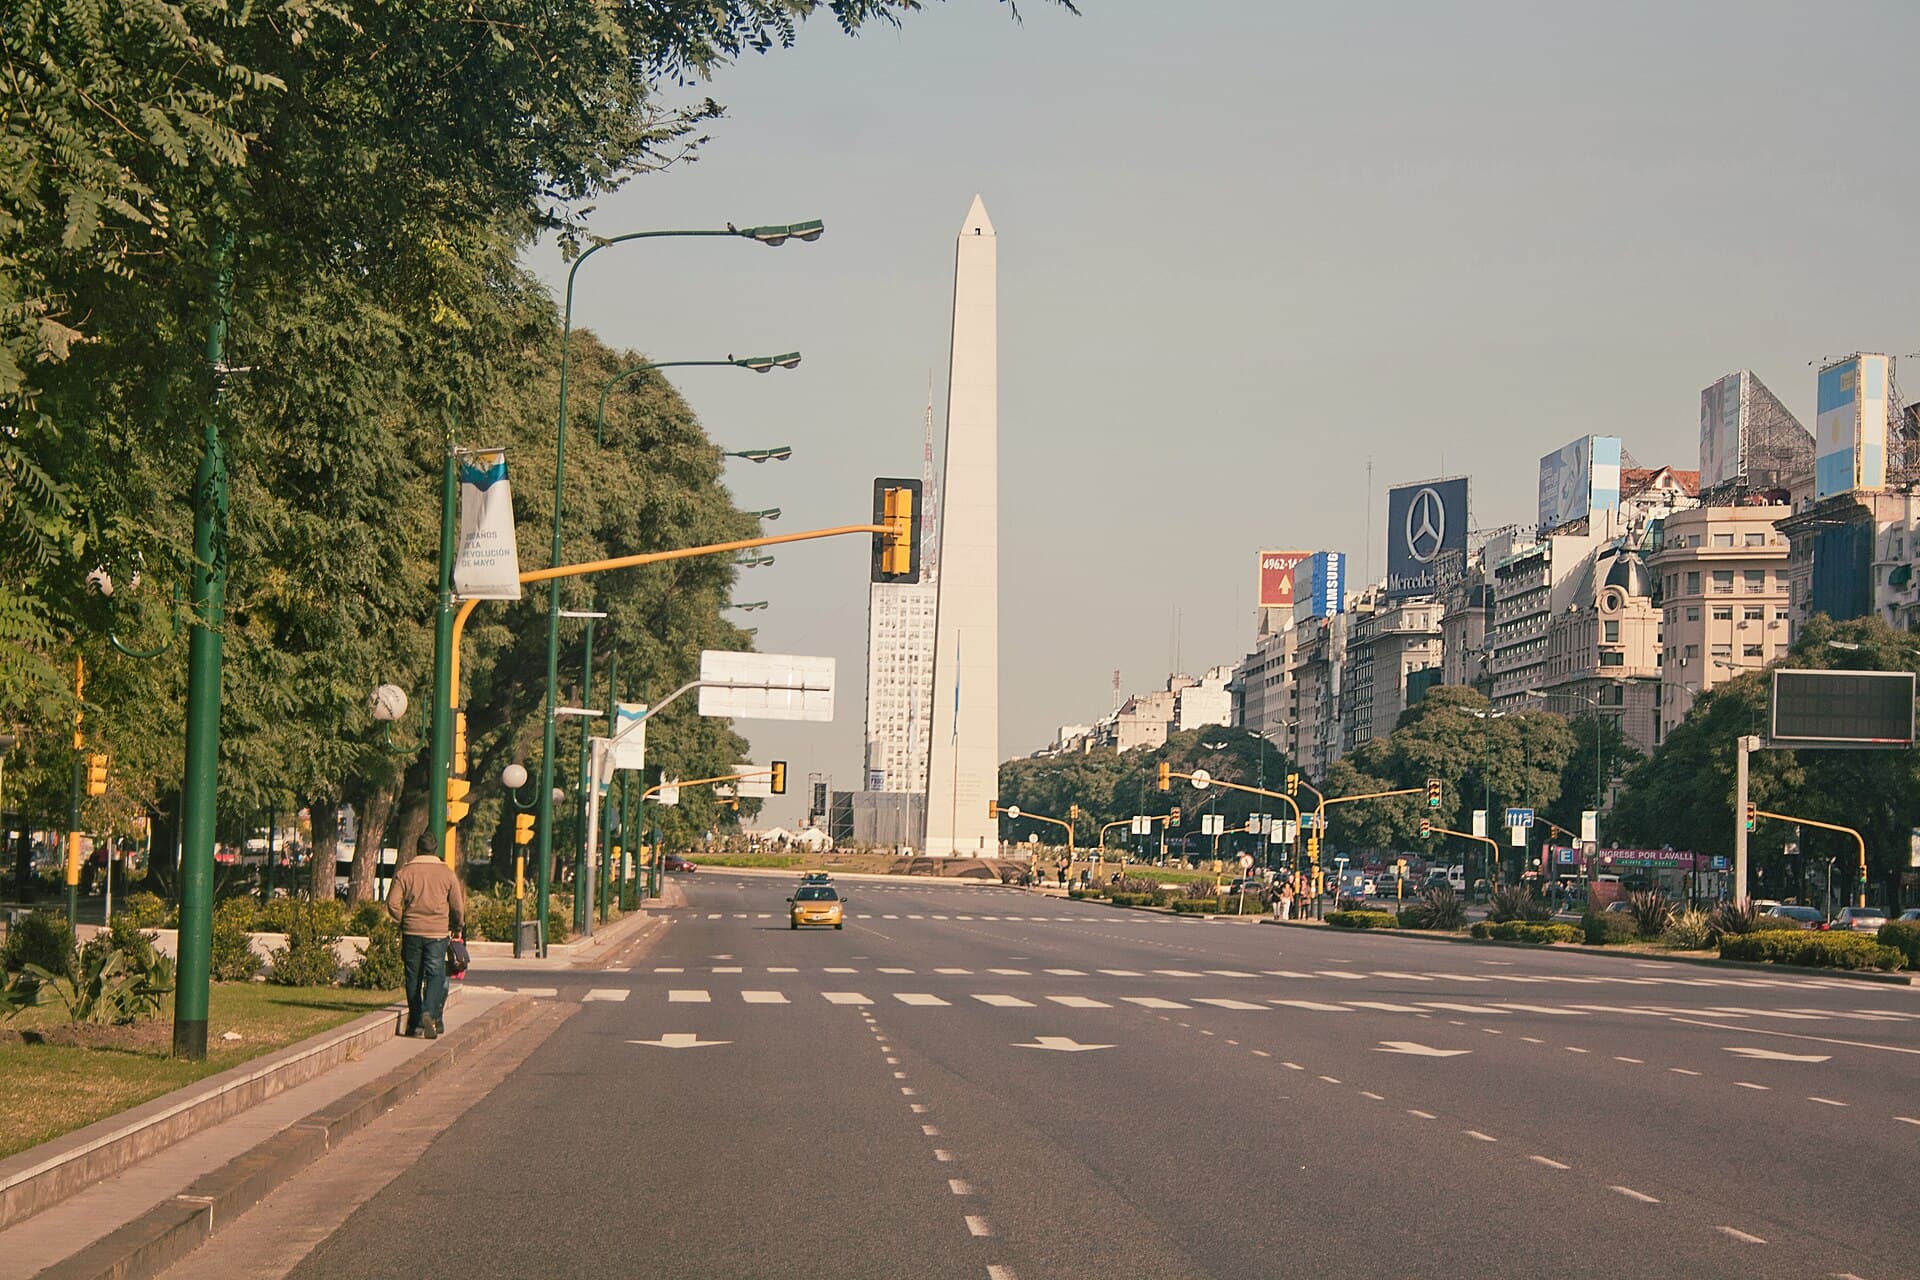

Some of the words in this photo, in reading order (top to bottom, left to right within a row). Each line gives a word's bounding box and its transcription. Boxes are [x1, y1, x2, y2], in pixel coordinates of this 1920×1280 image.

[473, 559, 495, 567] MAYO
[1326, 552, 1339, 617] SAMSUNG
[1561, 851, 1571, 862] E
[1599, 850, 1636, 859] INGRESE
[1638, 851, 1656, 860] POR
[1714, 856, 1725, 867] E
